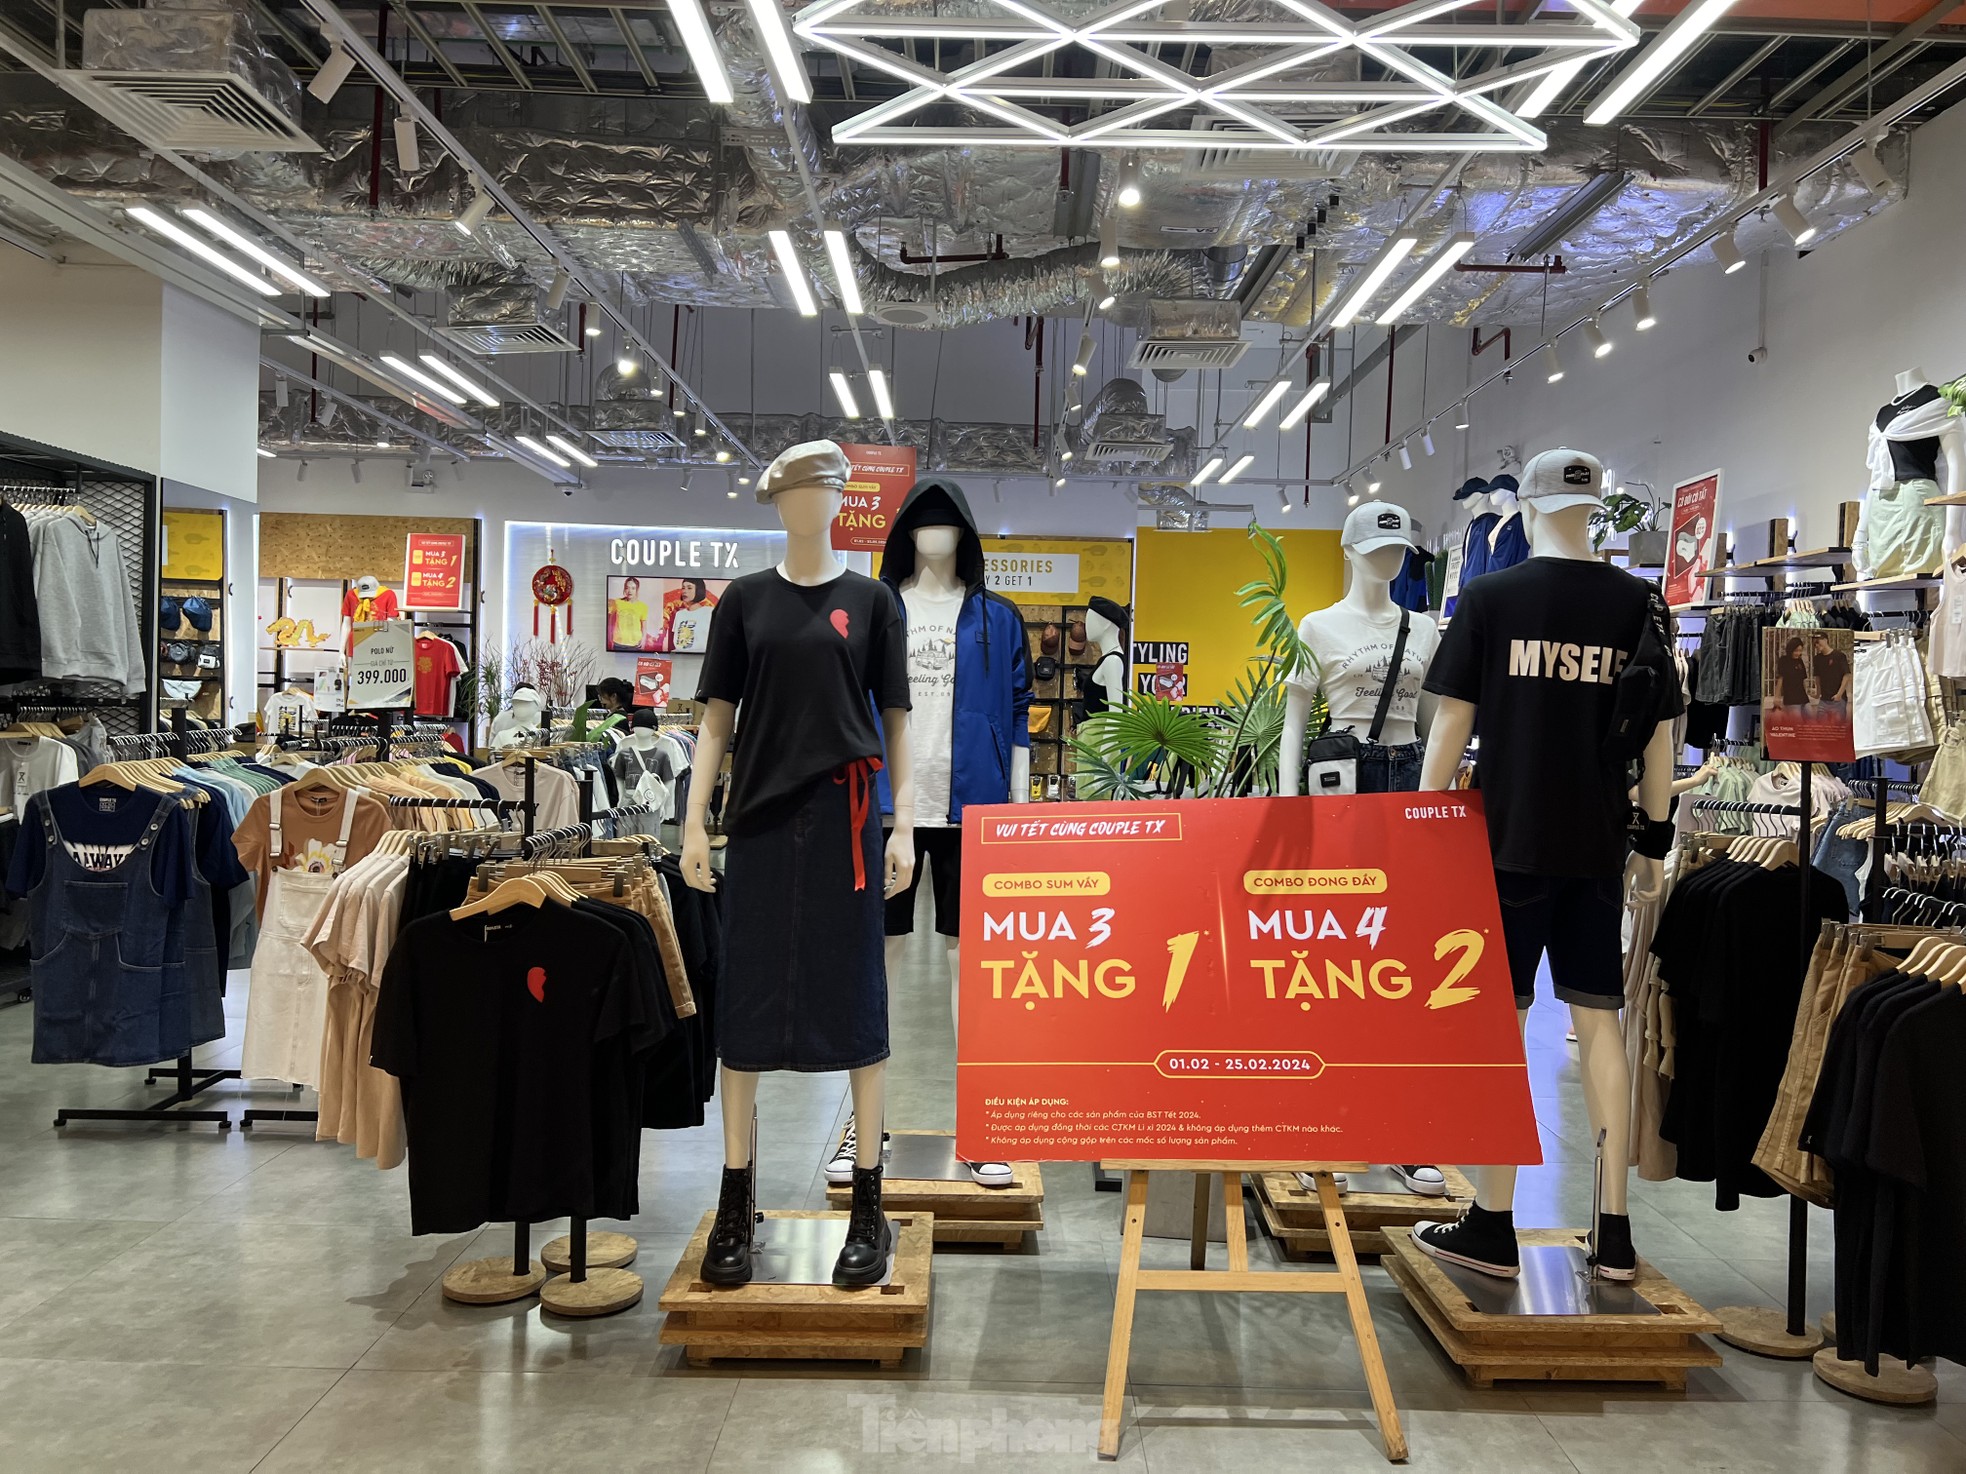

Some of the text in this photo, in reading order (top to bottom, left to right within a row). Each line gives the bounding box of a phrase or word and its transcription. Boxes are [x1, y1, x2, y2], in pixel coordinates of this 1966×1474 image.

[871, 496, 881, 510] 3
[838, 510, 886, 531] TẶNG
[611, 538, 739, 568] COUPLE TX
[425, 555, 457, 567] TẶNG 1
[984, 559, 1053, 573] ESSORIES
[422, 576, 456, 588] TẶNG 2
[995, 575, 1000, 585] 2
[1005, 576, 1022, 586] GET
[1028, 576, 1032, 586] 1
[1134, 643, 1187, 663] YLING
[1342, 644, 1378, 669] RHYTHM
[1508, 639, 1628, 685] MYSELF
[358, 668, 406, 684] 399.000
[906, 674, 939, 686] eeling
[1405, 806, 1466, 819] COUPLE TX
[996, 819, 1166, 837] VUI TẾT CÙNG COUPLE TX
[994, 880, 1042, 890] COMBO
[1047, 879, 1073, 889] SUM
[1254, 877, 1304, 887] COMBO
[1308, 877, 1348, 886] ĐONG
[983, 907, 1115, 949] MUA 3
[1248, 906, 1388, 950] MUA 4
[981, 930, 1199, 1013] TẶNG 1
[1250, 928, 1484, 1011] TẶNG 2
[1169, 1058, 1209, 1069] 01.02
[1225, 1059, 1310, 1070] 25.02.2024
[985, 1097, 1069, 1107] ĐIỀU KIỆN ÁP DỤNG:
[991, 1110, 1002, 1119] Áp
[1004, 1111, 1025, 1119] dụng
[1028, 1111, 1048, 1119] riêng
[1050, 1110, 1066, 1118] cho
[1179, 1111, 1201, 1119] 2024.
[1015, 1124, 1026, 1132] áp
[1028, 1124, 1049, 1132] dụng
[1094, 1124, 1109, 1132] các
[1156, 1124, 1176, 1132] 2024
[1179, 1124, 1184, 1132] &
[1187, 1124, 1212, 1133] không
[1214, 1124, 1226, 1132] áp
[1228, 1124, 1249, 1133] dụng
[1251, 1124, 1273, 1132] thêm
[1275, 1124, 1299, 1132] CTKM
[991, 1137, 1017, 1145] Không
[1020, 1137, 1031, 1145] áp
[1033, 1137, 1056, 1145] dụng
